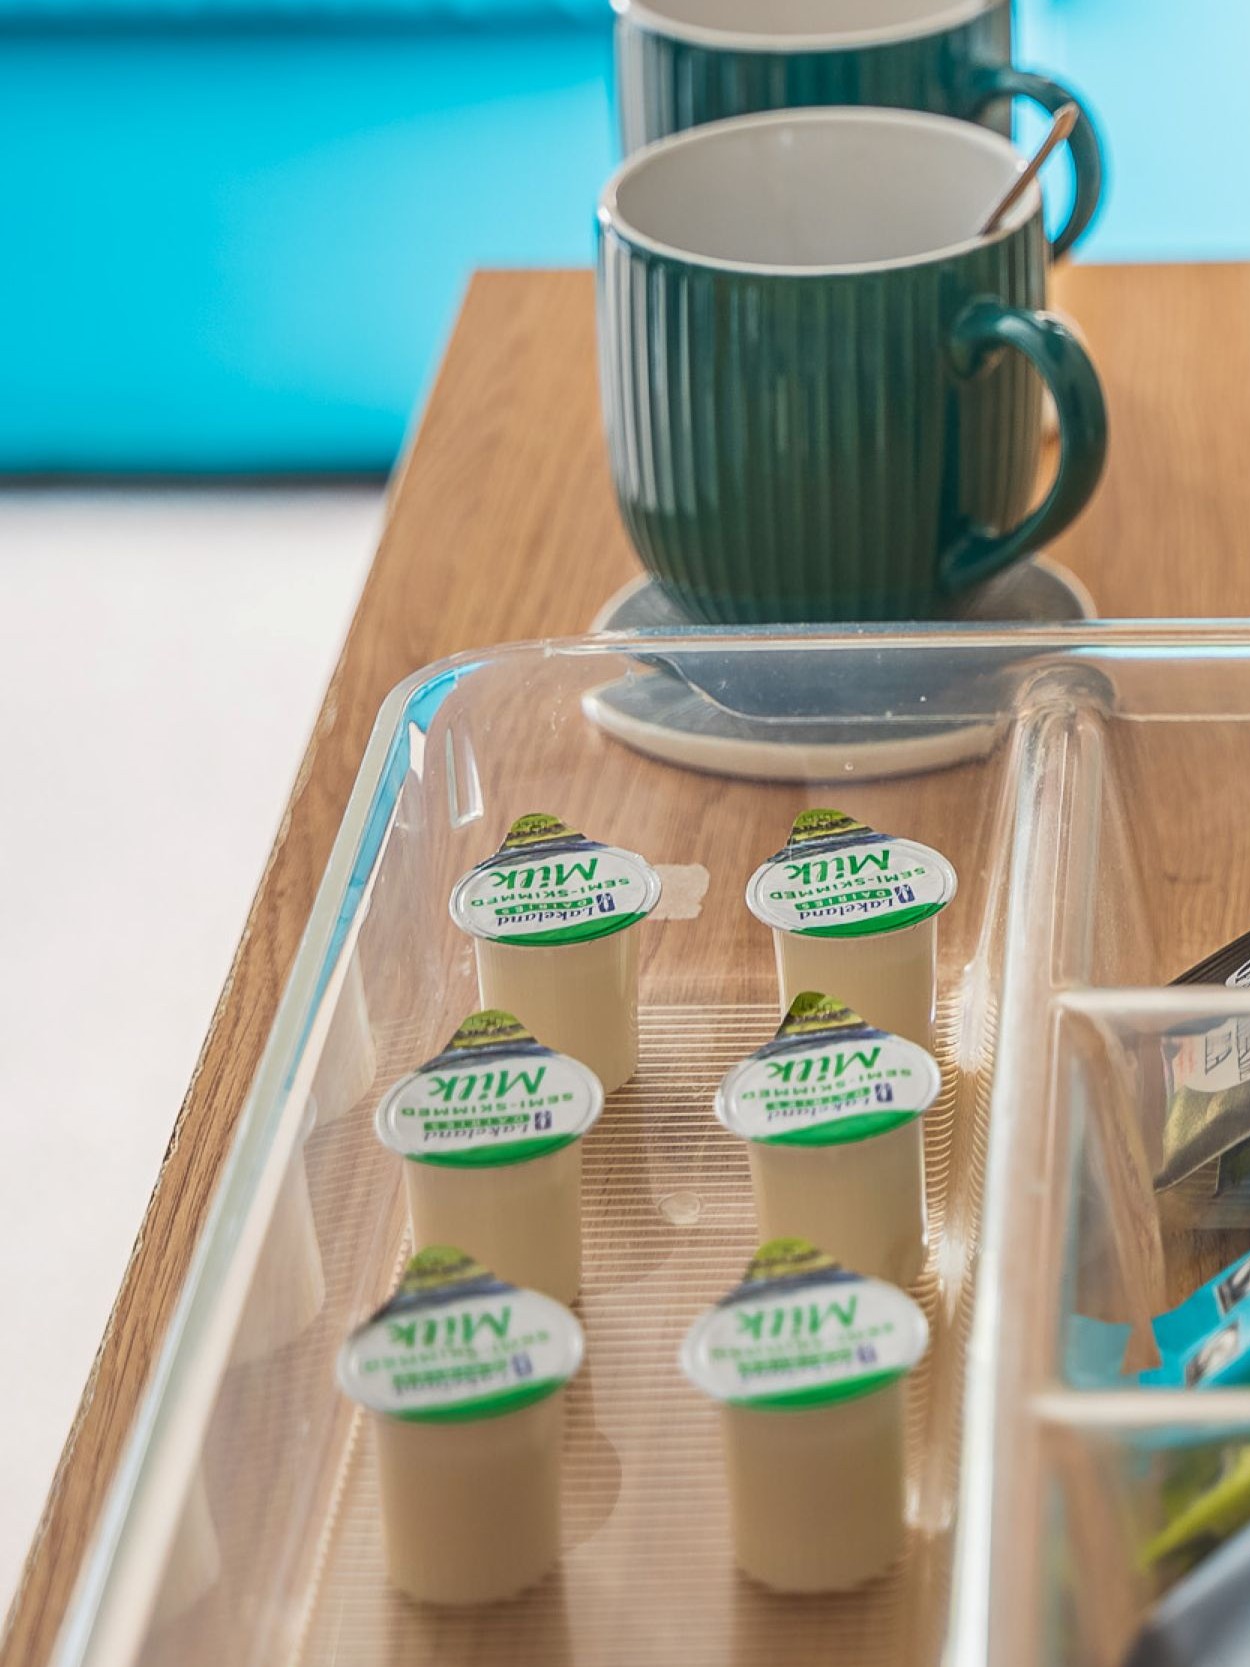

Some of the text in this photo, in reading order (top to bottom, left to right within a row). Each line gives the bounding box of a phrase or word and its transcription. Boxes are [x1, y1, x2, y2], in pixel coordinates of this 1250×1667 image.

[488, 858, 598, 890] Milk
[770, 867, 926, 900] SEMI-SKIMMED
[784, 850, 890, 885] Milk
[471, 878, 631, 907] SEMI-SKIMMED
[500, 897, 590, 915] DAIRIES
[799, 889, 888, 910] DAIRIES
[497, 907, 594, 927] Lakeland
[799, 898, 893, 921] Lakeland
[766, 1047, 881, 1082] Milk
[428, 1066, 547, 1101] Milk
[402, 1092, 573, 1117] SEMI-SKIMMED
[388, 1305, 511, 1348] Milk
[737, 1295, 857, 1340] Milk
